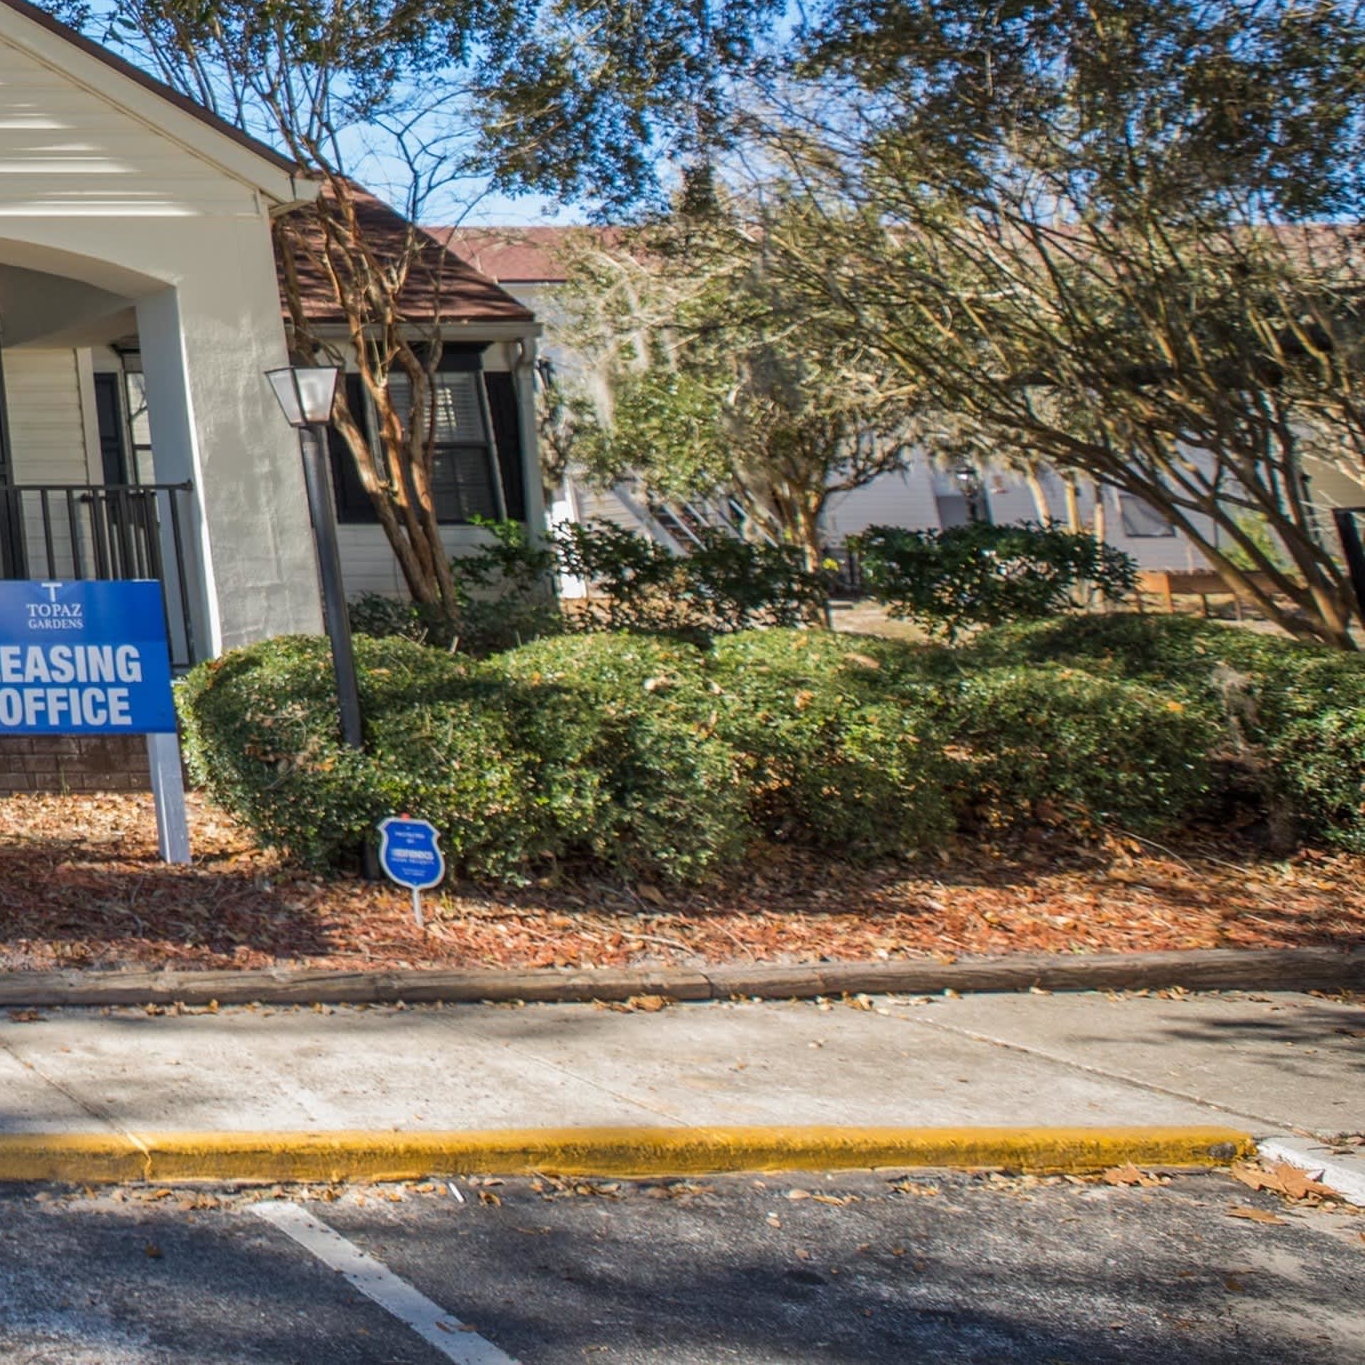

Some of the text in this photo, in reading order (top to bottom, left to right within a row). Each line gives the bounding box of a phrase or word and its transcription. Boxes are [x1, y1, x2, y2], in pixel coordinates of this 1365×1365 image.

[41, 582, 63, 602] T
[27, 604, 82, 617] TOPAZ
[28, 619, 84, 629] GARDENS
